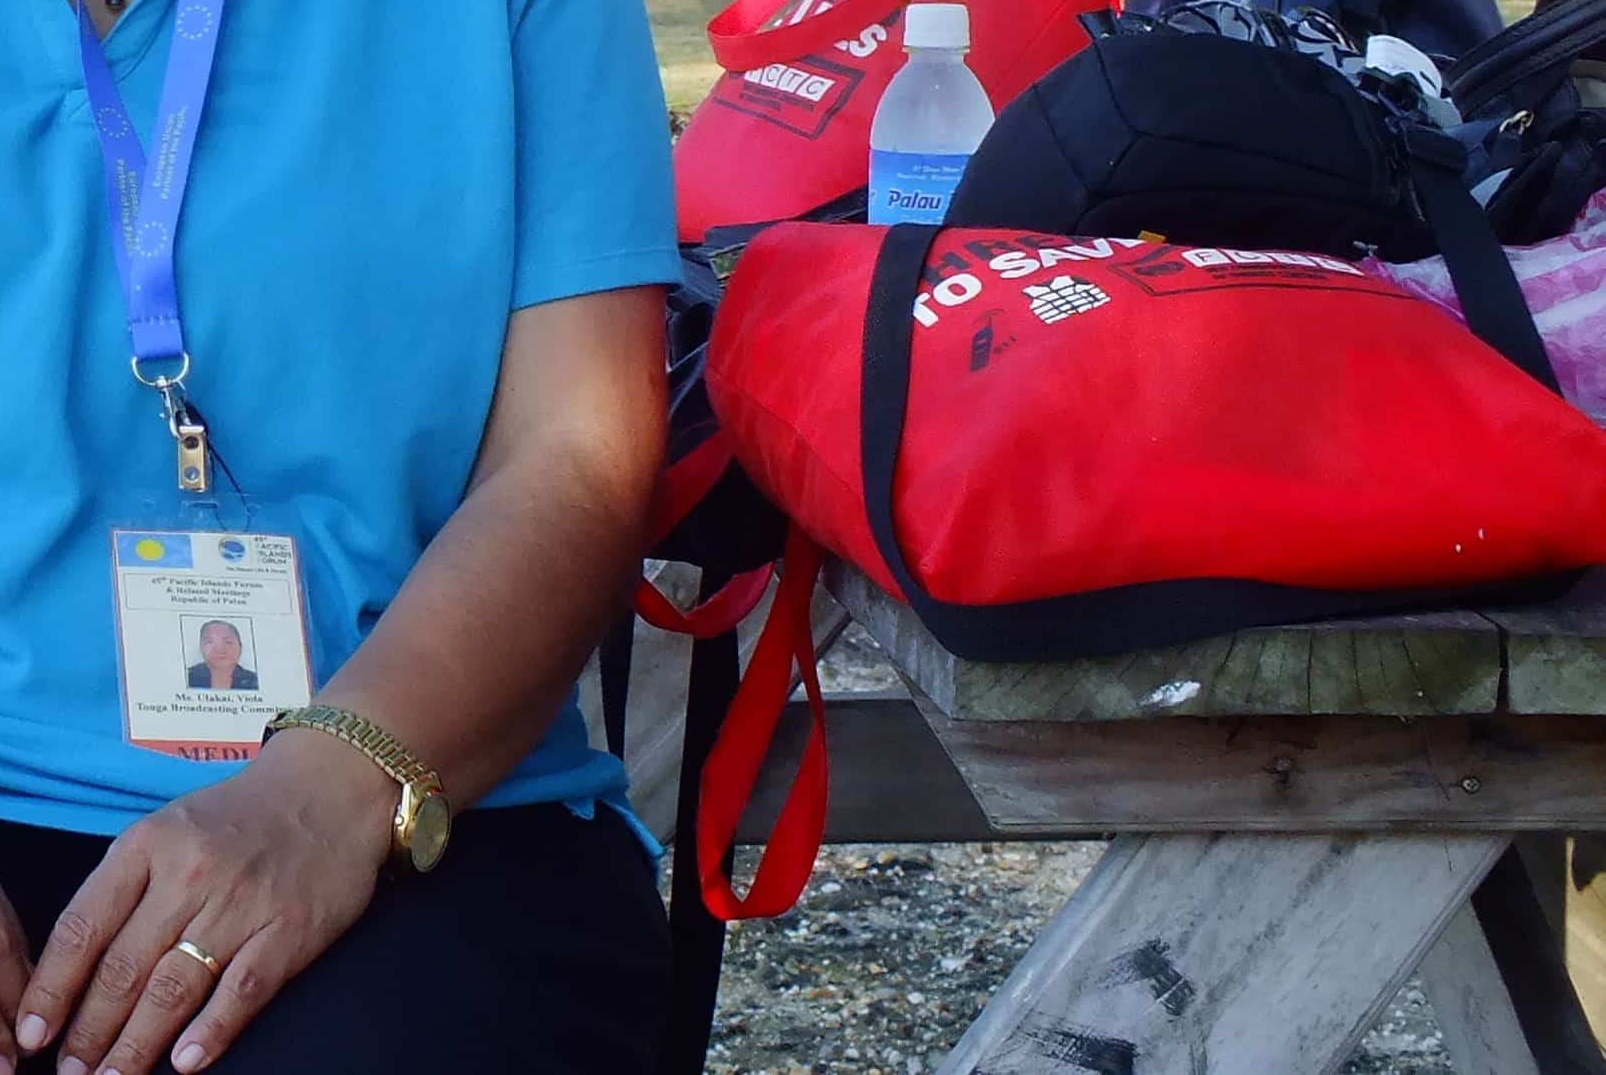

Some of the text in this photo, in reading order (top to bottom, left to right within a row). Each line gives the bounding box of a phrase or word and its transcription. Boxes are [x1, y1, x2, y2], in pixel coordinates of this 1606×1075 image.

[747, 65, 828, 97] CTC
[888, 189, 941, 209] Palau
[913, 273, 982, 327] TO
[170, 578, 198, 586] Pacific
[201, 579, 231, 588] Islands
[171, 595, 208, 604] Republic
[223, 598, 247, 606] Palau
[237, 694, 263, 703] Viola
[138, 702, 168, 713] Tonga
[171, 703, 238, 715] Broadcasting
